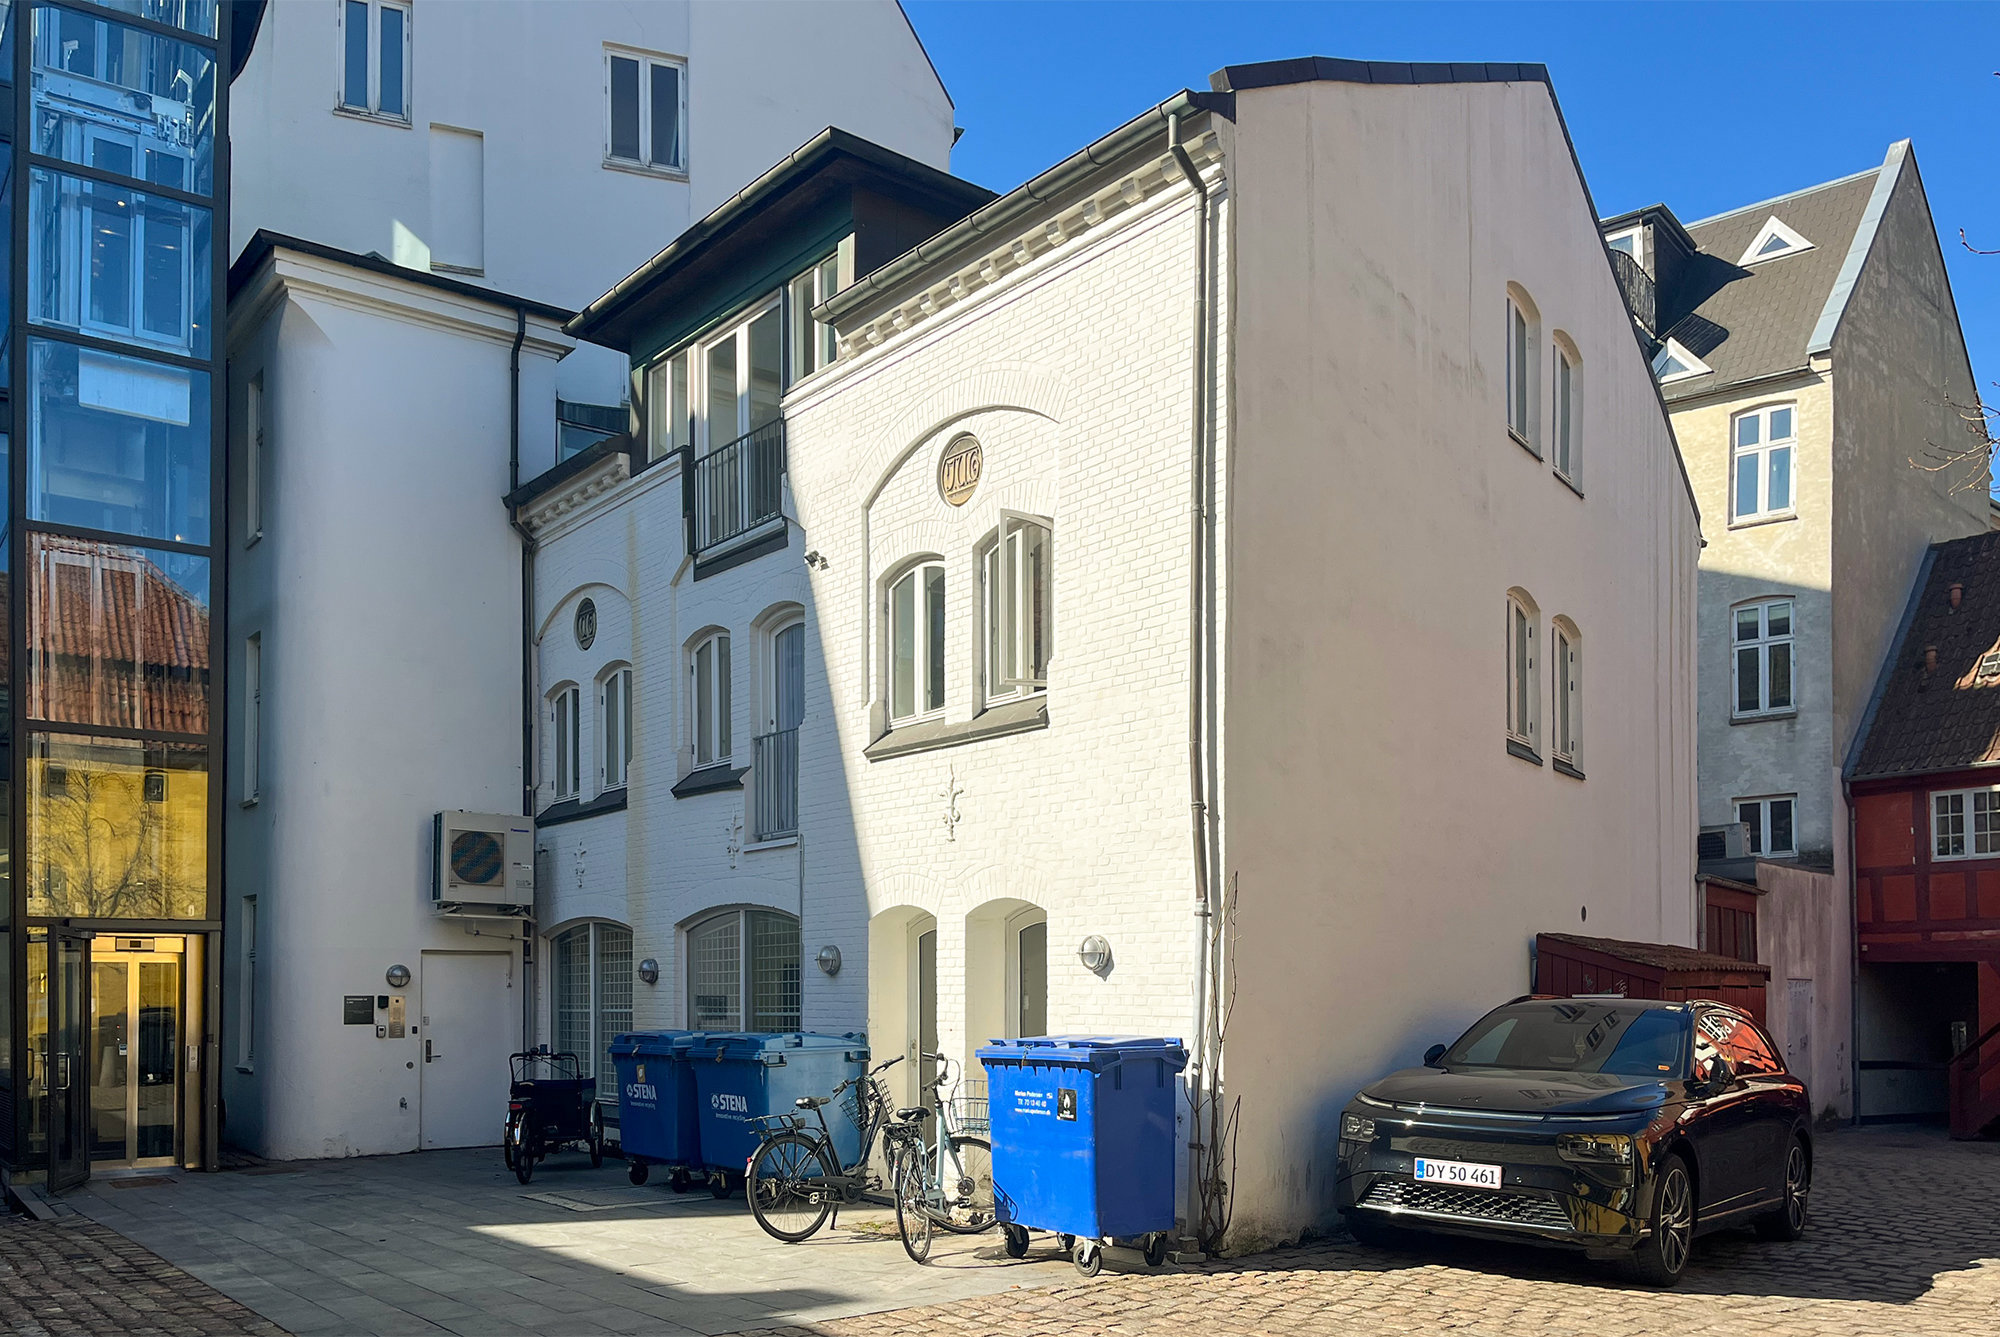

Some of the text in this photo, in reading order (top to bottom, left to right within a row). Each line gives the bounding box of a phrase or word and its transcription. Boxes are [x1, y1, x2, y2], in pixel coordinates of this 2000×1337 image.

[633, 1083, 657, 1100] STENA
[719, 1094, 748, 1113] STENA
[1426, 1163, 1496, 1185] DY 50 461
